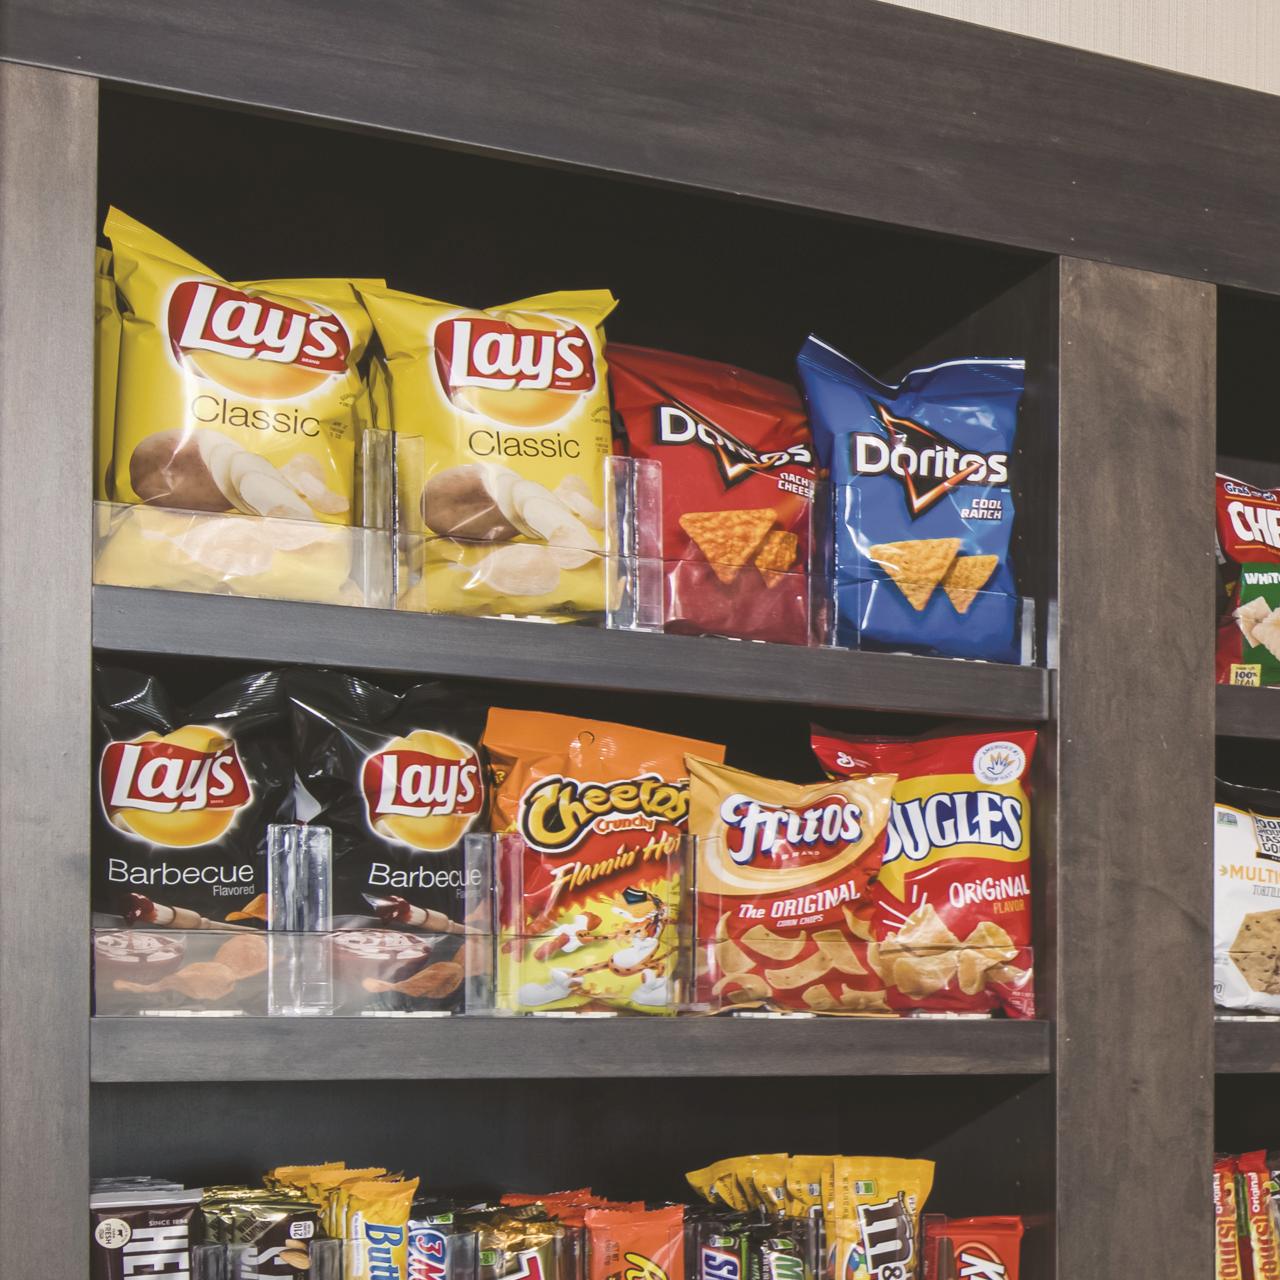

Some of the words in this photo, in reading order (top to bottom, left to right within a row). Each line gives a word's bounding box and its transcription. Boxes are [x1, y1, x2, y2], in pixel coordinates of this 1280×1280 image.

[180, 284, 340, 364] Lay's
[449, 320, 585, 392] Lay's
[190, 394, 321, 438] Classic
[659, 406, 813, 467] Doritos
[468, 429, 580, 459] Classic
[854, 435, 1009, 483] Doritos
[960, 508, 1002, 521] RANCH
[972, 499, 1002, 510] COOL
[110, 744, 235, 814] Lay's
[376, 754, 477, 817] Lay's
[527, 779, 690, 846] Cheetos
[594, 814, 655, 833] Crunchy
[720, 793, 863, 865] Fritos
[108, 858, 255, 885] Barbecue
[368, 863, 482, 888] Barbecue
[550, 845, 639, 891] Flamin'
[212, 884, 255, 897] Flavored
[739, 903, 766, 919] The
[771, 880, 861, 918] ORIGINAL
[993, 900, 1025, 914] FLAVOR
[415, 1235, 444, 1257] 3
